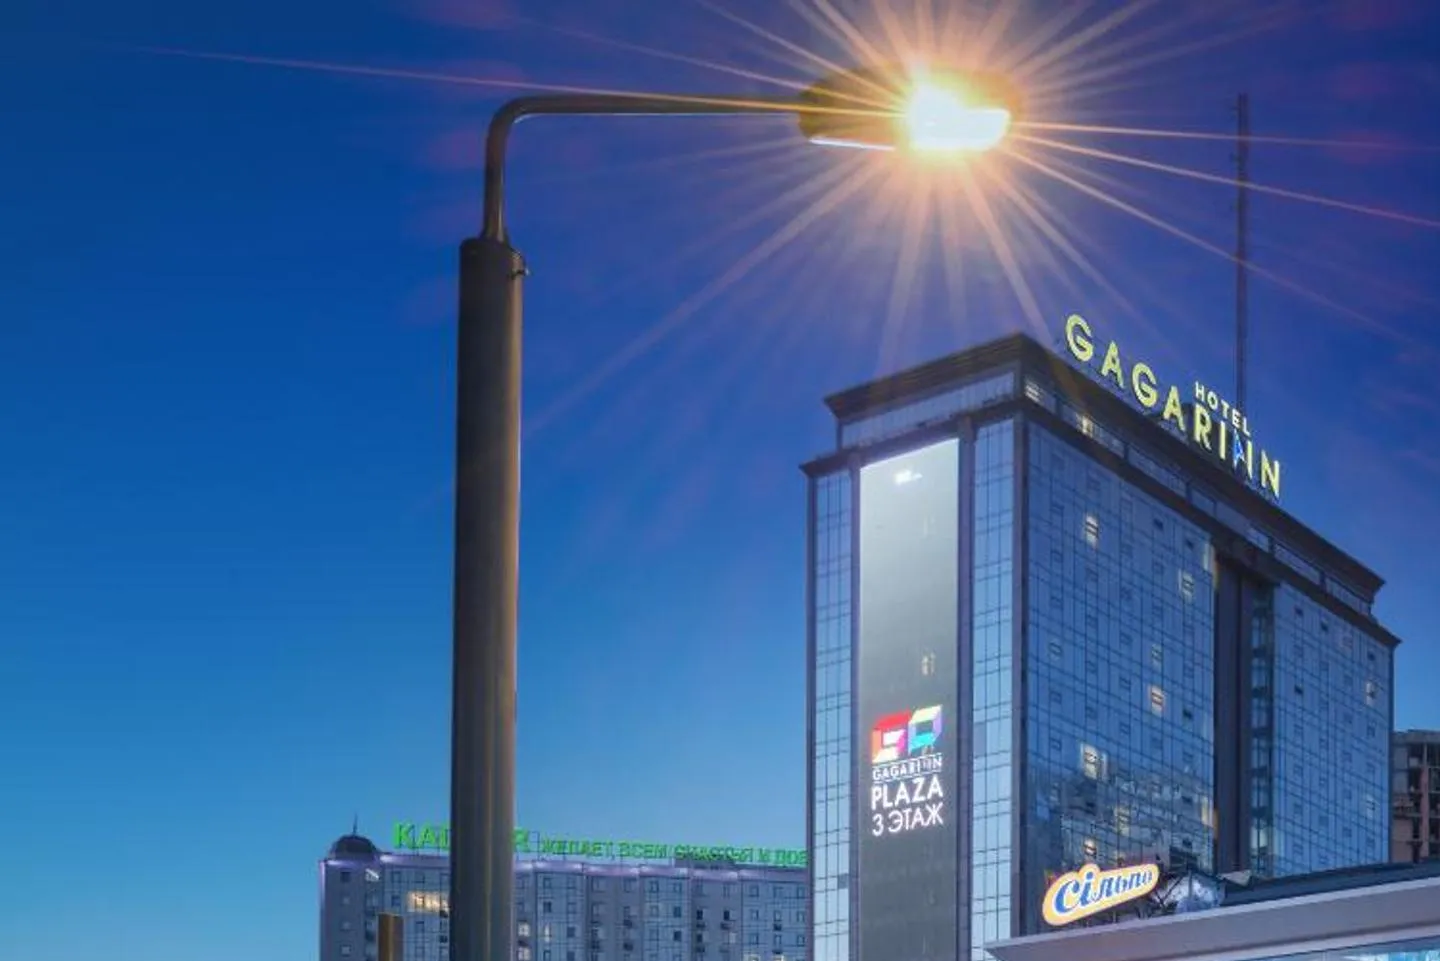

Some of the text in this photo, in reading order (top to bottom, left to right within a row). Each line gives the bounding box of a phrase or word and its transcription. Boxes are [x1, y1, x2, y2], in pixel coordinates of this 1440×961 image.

[1065, 313, 1281, 498] GAGARINN
[1195, 381, 1251, 437] HOTEL
[871, 775, 944, 811] PLAZA
[872, 802, 944, 836] 3 ЭТАЖ
